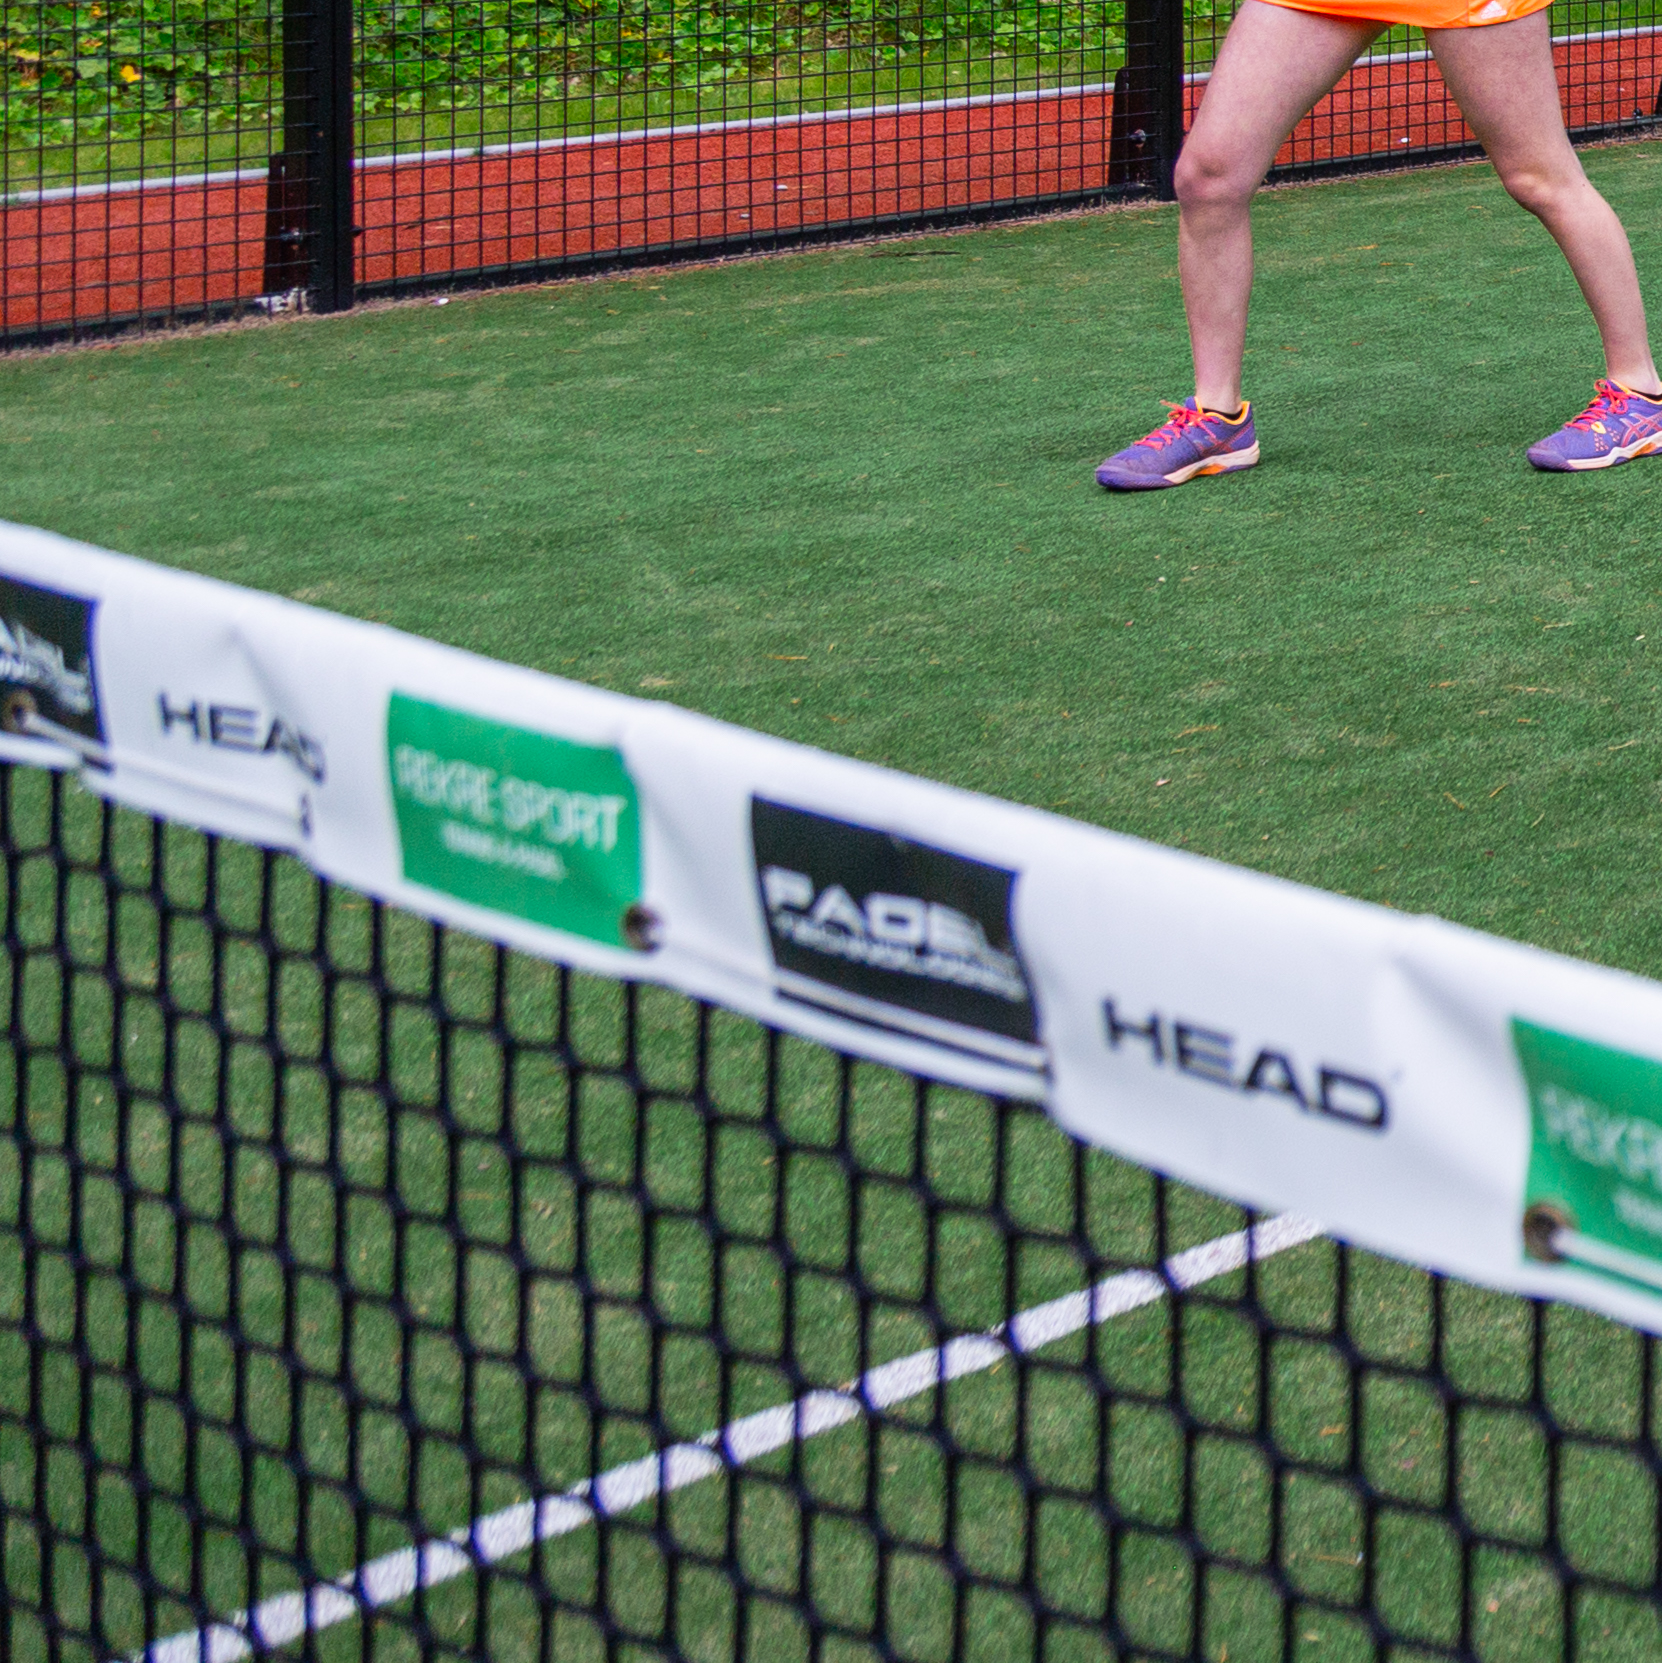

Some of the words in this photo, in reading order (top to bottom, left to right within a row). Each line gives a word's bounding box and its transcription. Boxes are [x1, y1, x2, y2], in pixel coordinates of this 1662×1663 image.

[499, 775, 628, 853] SPORT
[762, 864, 1014, 978] PADEL
[1100, 994, 1391, 1133] HEAD
